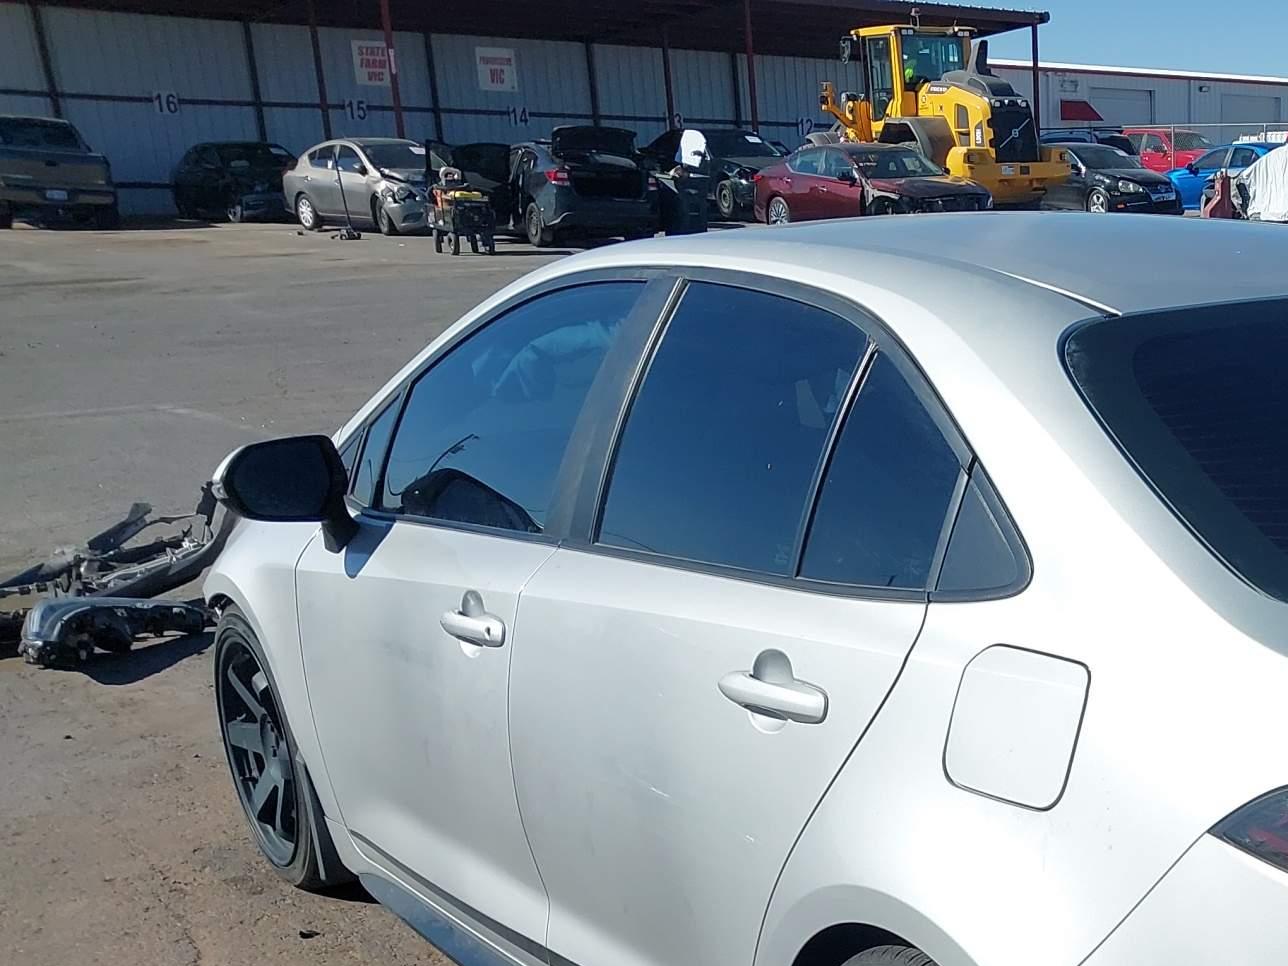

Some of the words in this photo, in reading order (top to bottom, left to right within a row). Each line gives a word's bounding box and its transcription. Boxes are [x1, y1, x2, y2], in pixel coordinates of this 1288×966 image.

[360, 58, 387, 70] FARM
[367, 71, 384, 82] VIC
[489, 68, 505, 85] VIC
[154, 93, 178, 113] 16
[346, 101, 367, 121] 15
[510, 106, 529, 127] 14
